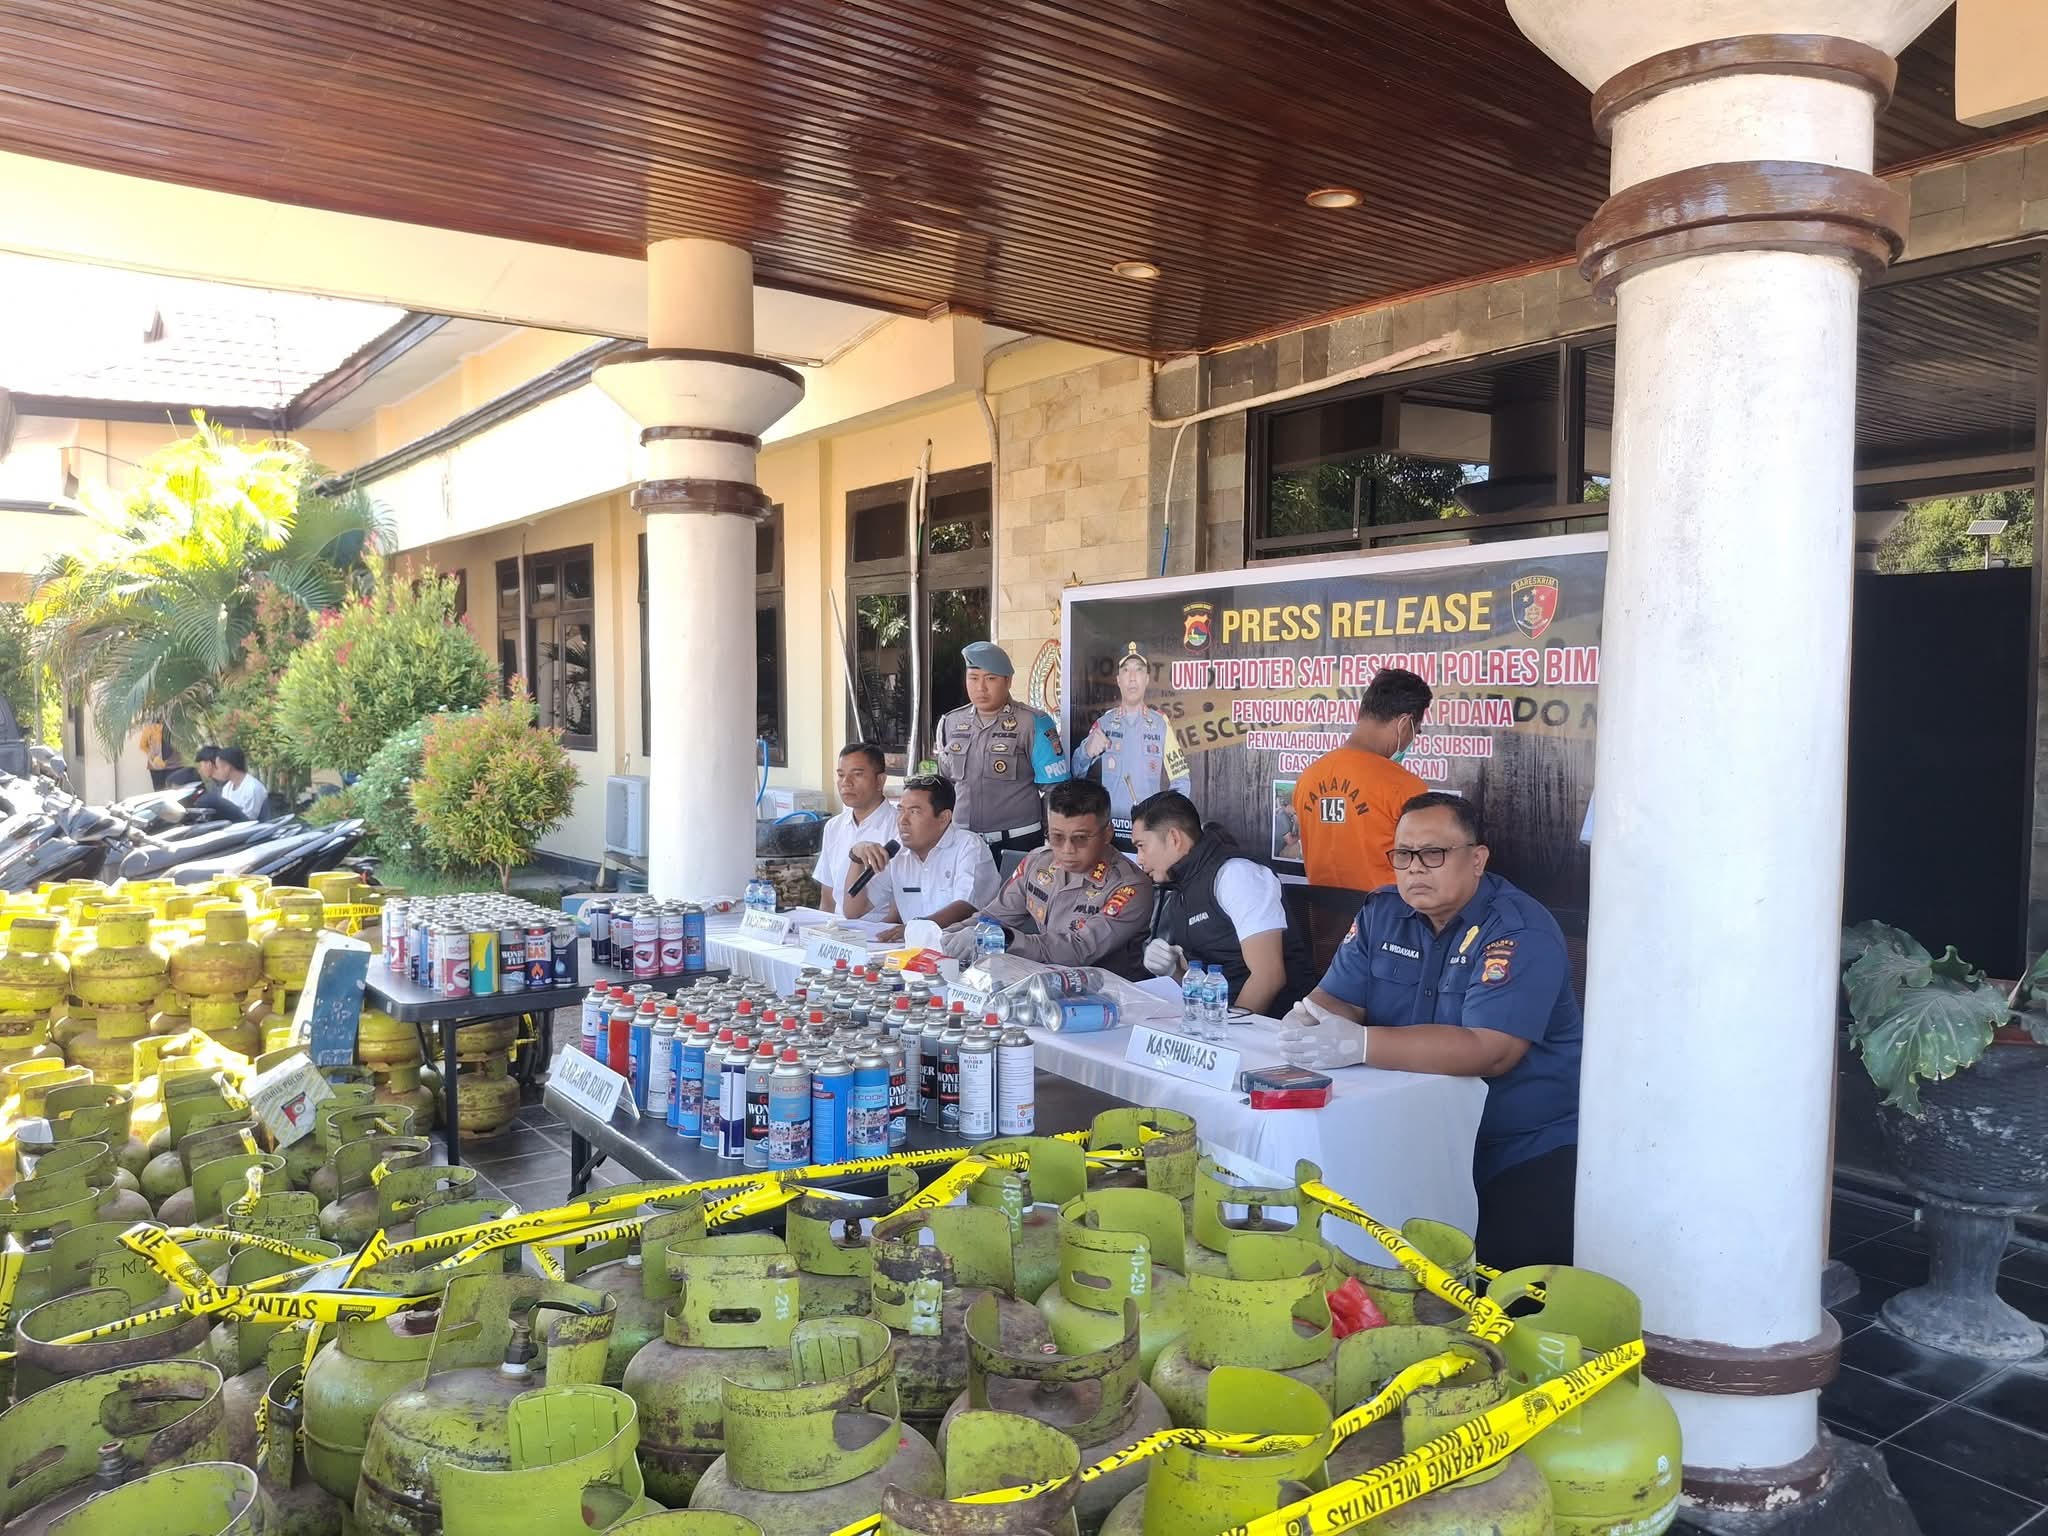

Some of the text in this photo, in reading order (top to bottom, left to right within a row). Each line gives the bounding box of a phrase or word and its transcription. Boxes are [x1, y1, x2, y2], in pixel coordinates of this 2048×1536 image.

[1222, 591, 1493, 644] PRESS RELEASE
[1171, 660, 1211, 690] UNIT
[1214, 656, 1295, 690] TIPIDTER
[1298, 655, 1337, 688] SAT
[1442, 648, 1540, 686] POLRES
[1543, 646, 1600, 685] BIM
[1438, 698, 1514, 727] PIDANA
[1247, 731, 1352, 751] PENYALAHGUNAA
[1432, 735, 1493, 757] SUBSIDI
[1304, 776, 1370, 816] TAHANAN
[1320, 798, 1346, 822] 145
[951, 988, 983, 1005] TIPIDTER
[1146, 1033, 1217, 1071] KASIHUMAS
[920, 1065, 935, 1076] DER
[944, 1064, 960, 1074] GA
[1327, 1430, 1510, 1531] DILARANG MELINTAS
